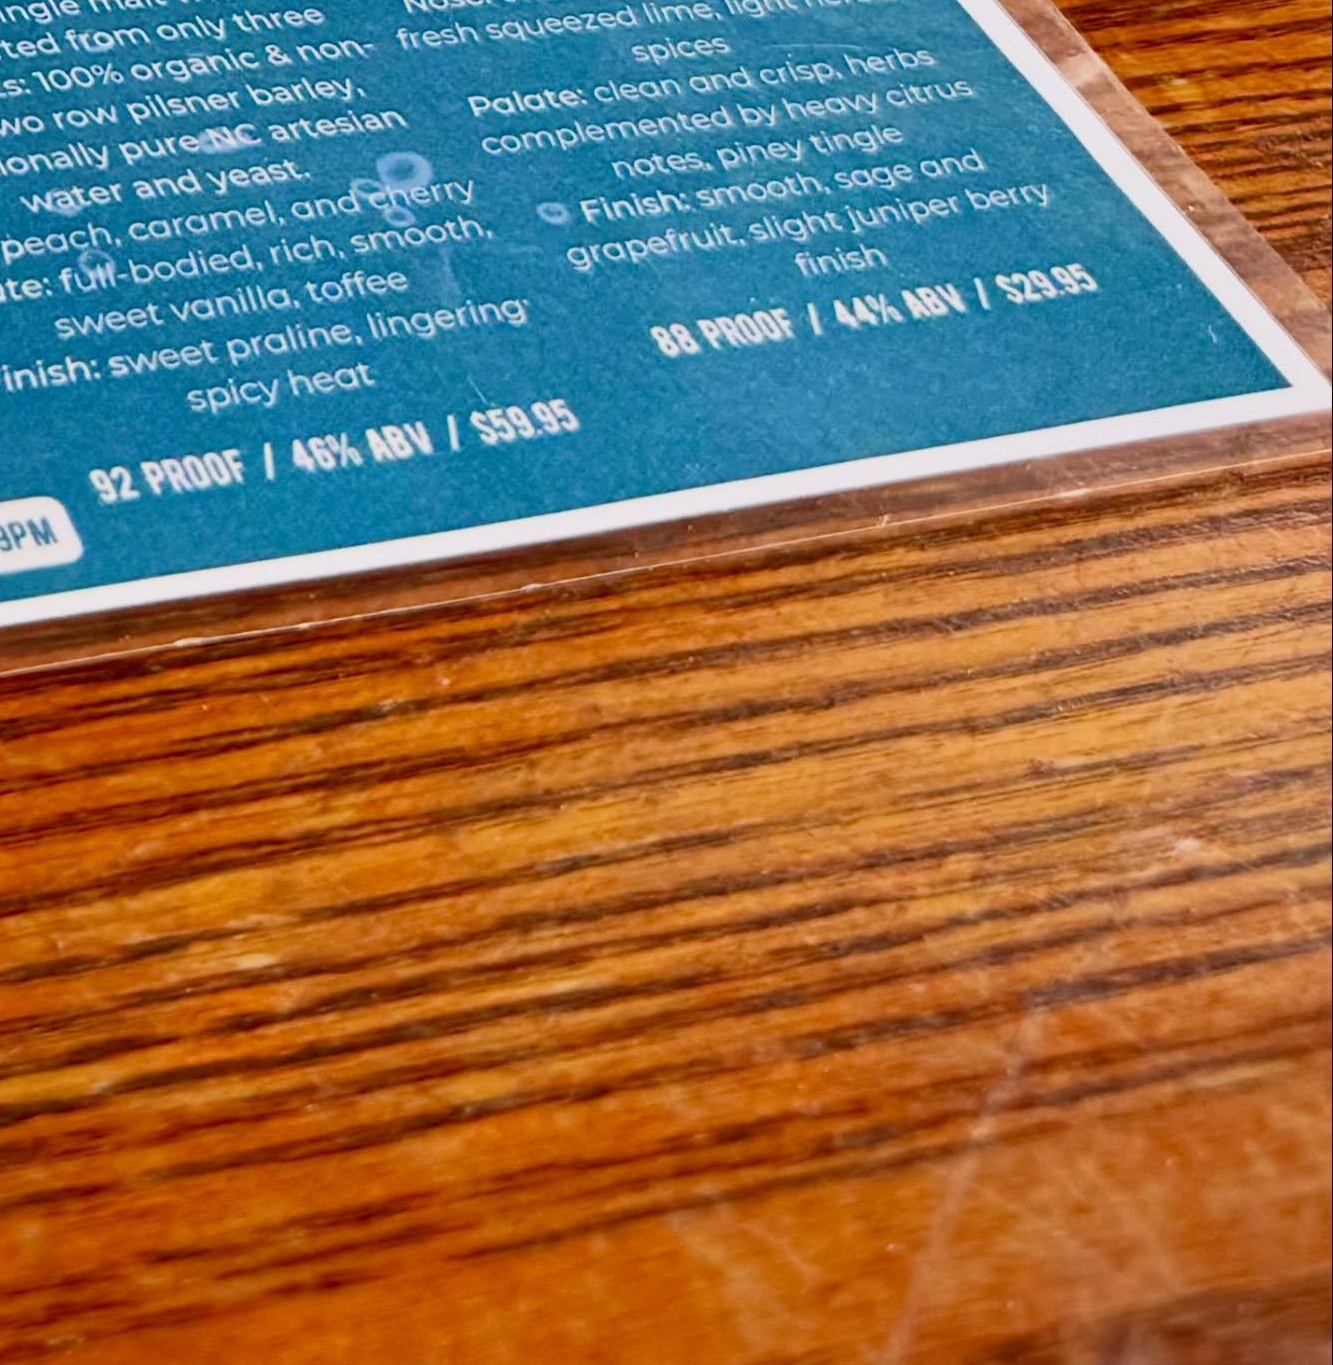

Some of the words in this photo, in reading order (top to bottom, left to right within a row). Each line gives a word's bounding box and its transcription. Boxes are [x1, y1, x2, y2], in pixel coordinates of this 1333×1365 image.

[565, 222, 747, 273] grapefruit,
[747, 209, 844, 244] slight
[846, 194, 960, 235] juniper
[963, 181, 1051, 211] berry
[107, 339, 219, 378] sweet
[225, 322, 364, 367] praline,
[365, 297, 529, 340] lingering
[649, 321, 702, 359] 88
[695, 305, 795, 350] PROOF
[832, 291, 905, 330] 44%
[900, 281, 967, 320] ABV
[993, 261, 1099, 306] $29.95
[88, 463, 141, 505] 92
[139, 446, 245, 496] PROOF
[290, 430, 365, 473] 46%
[364, 419, 435, 463] ABV
[468, 396, 581, 447] $59.95
